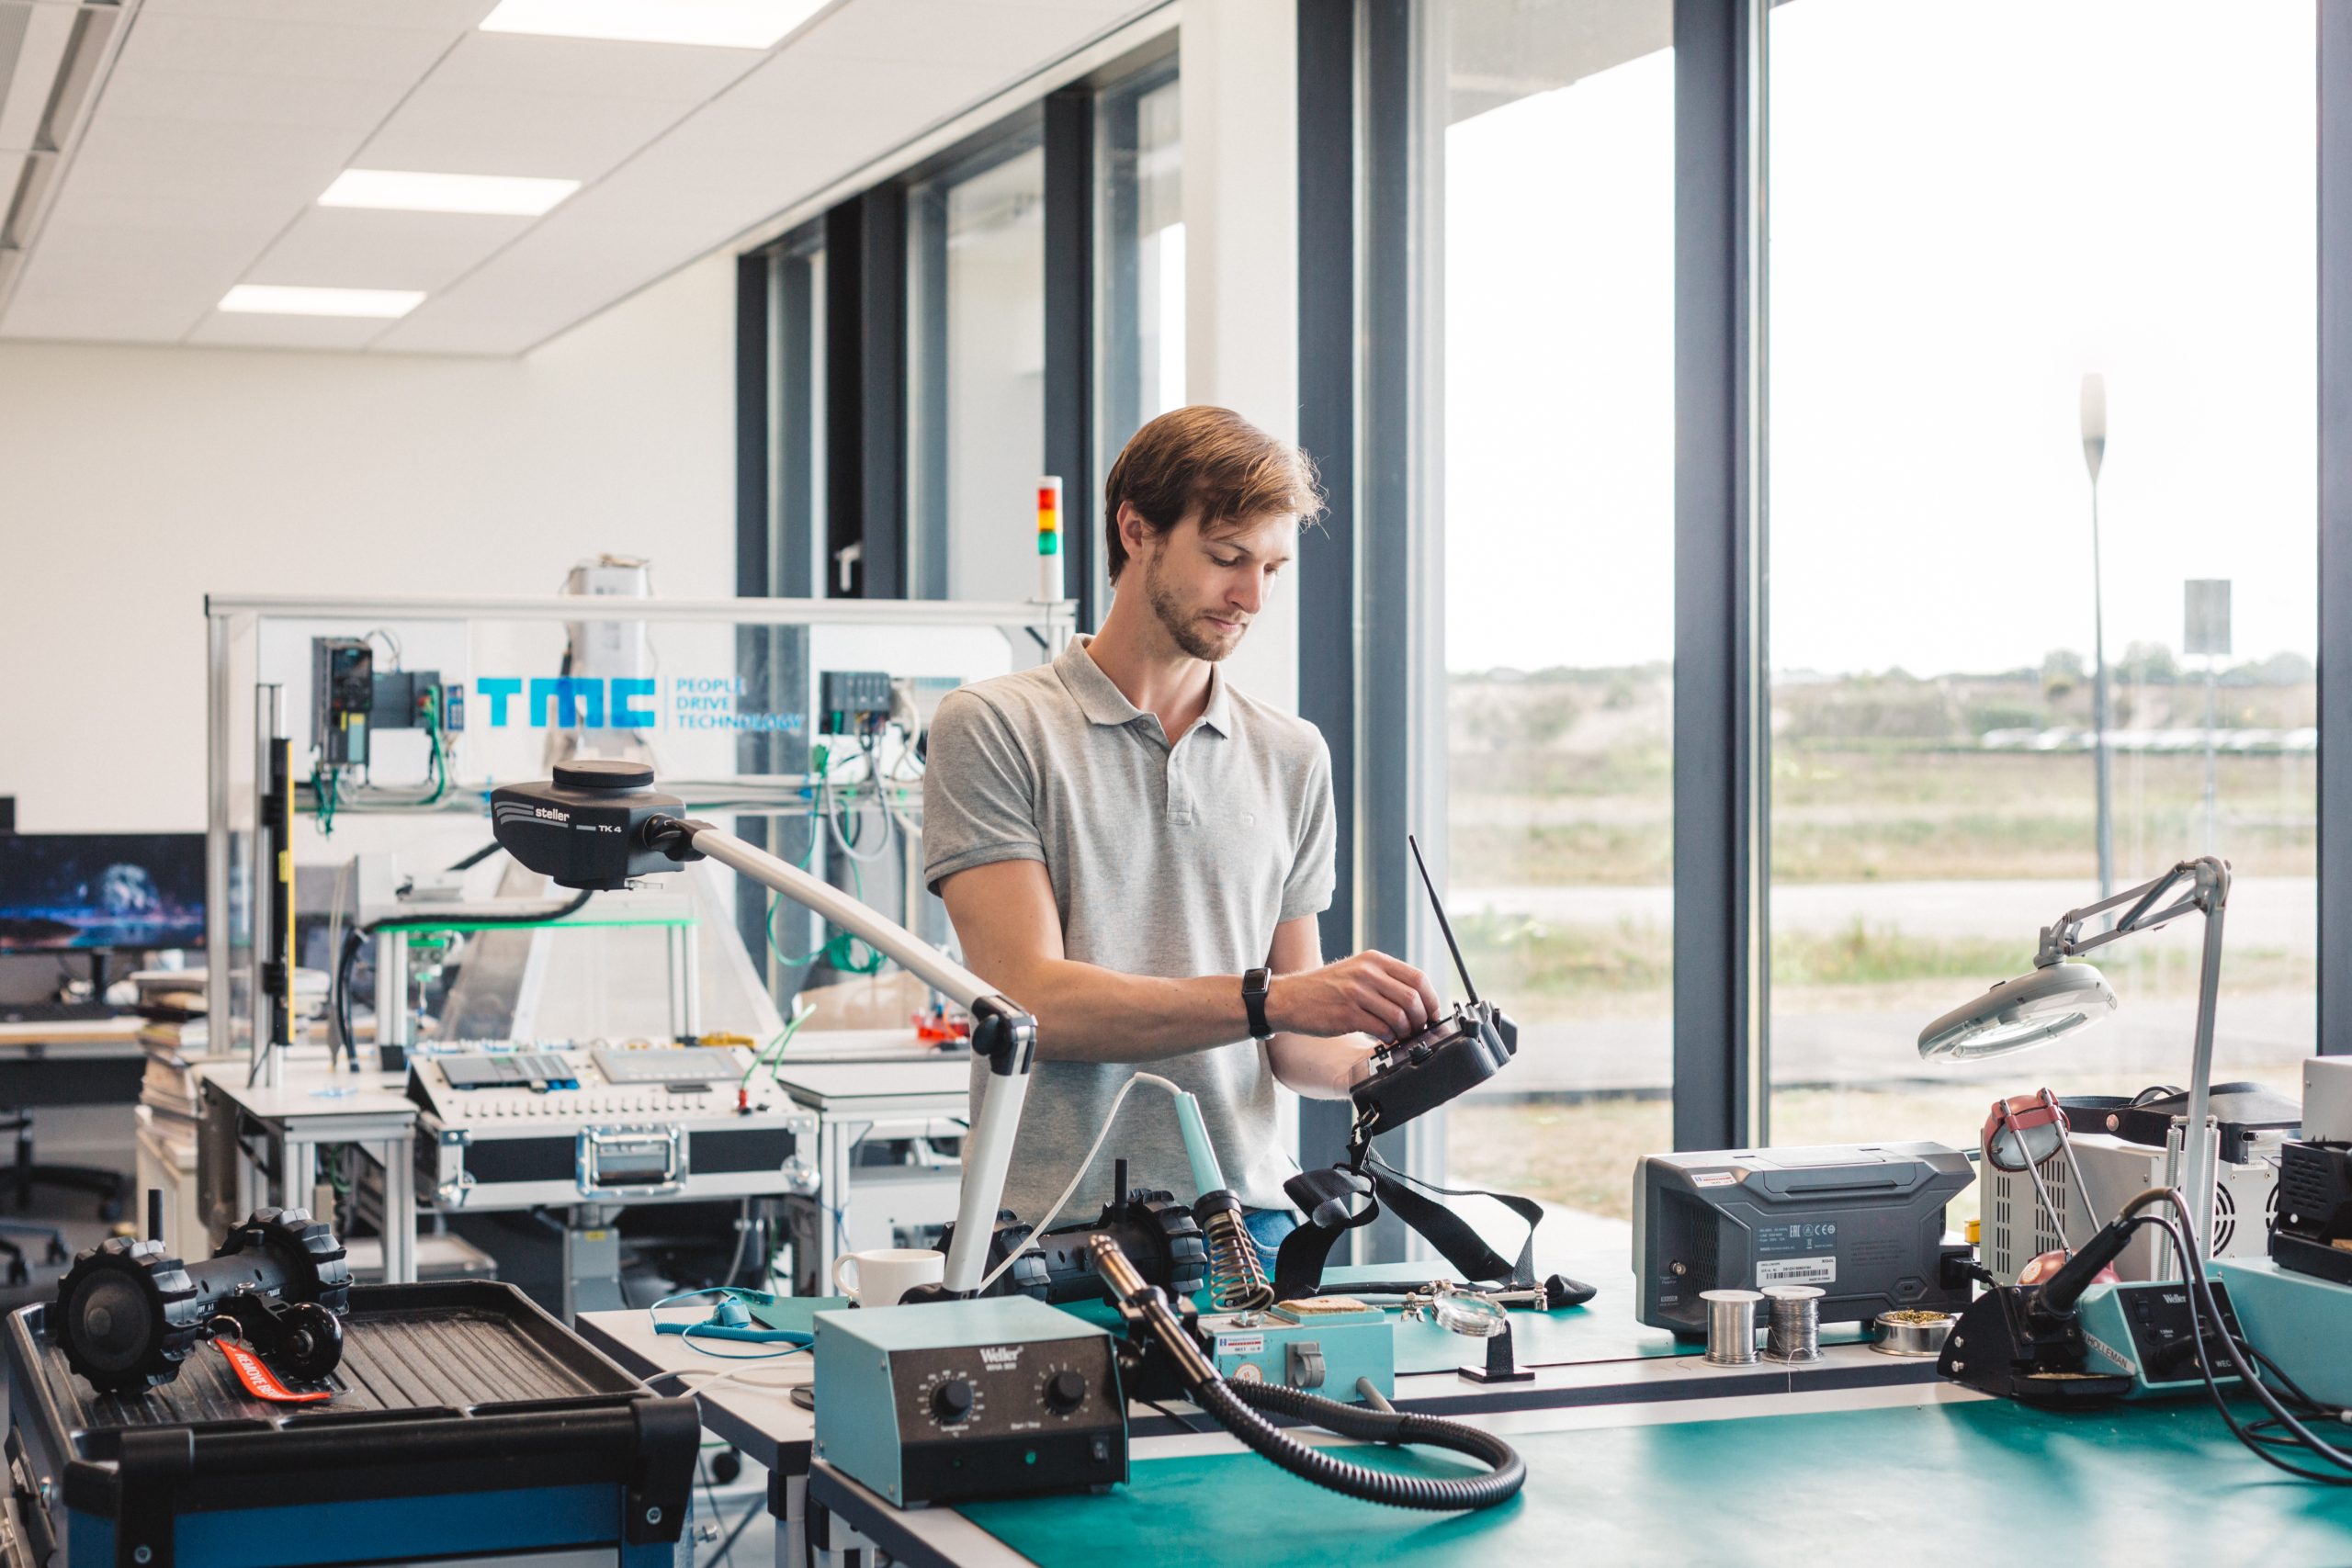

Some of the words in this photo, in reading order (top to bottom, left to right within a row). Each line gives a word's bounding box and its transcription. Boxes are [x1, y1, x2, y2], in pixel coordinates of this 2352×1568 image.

[676, 677, 743, 695] PEOPLE
[477, 678, 655, 728] TMC
[676, 695, 729, 711] DRIVE
[678, 712, 803, 731] TECHNOLOGY
[535, 807, 570, 822] steller
[598, 825, 613, 833] TK
[2162, 1293, 2187, 1303] Weller
[979, 1347, 1018, 1363] Weller
[2086, 1335, 2127, 1369] HOLLEMAN
[235, 1353, 267, 1386] REMOVE
